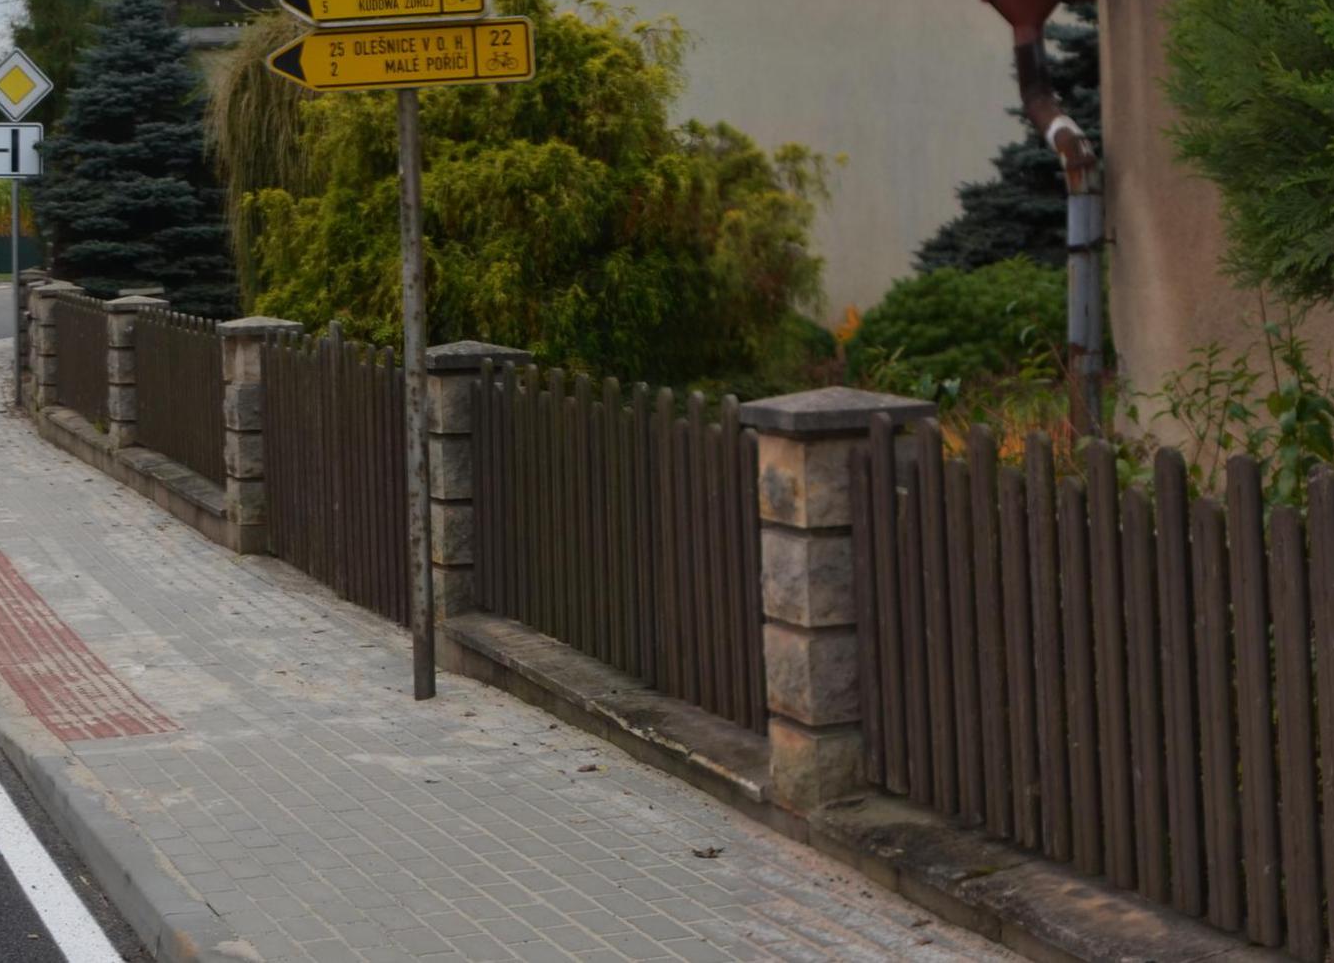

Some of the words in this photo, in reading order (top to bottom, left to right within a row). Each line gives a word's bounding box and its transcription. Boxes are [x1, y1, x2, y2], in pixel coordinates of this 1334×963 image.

[322, 1, 329, 14] 5
[329, 41, 345, 57] 25
[354, 36, 416, 56] OLEŠNICE
[422, 37, 431, 51] V
[490, 29, 512, 46] 22
[330, 62, 339, 77] 2
[385, 55, 420, 74] MALÉ
[426, 52, 469, 72] POŘÍČÍ
